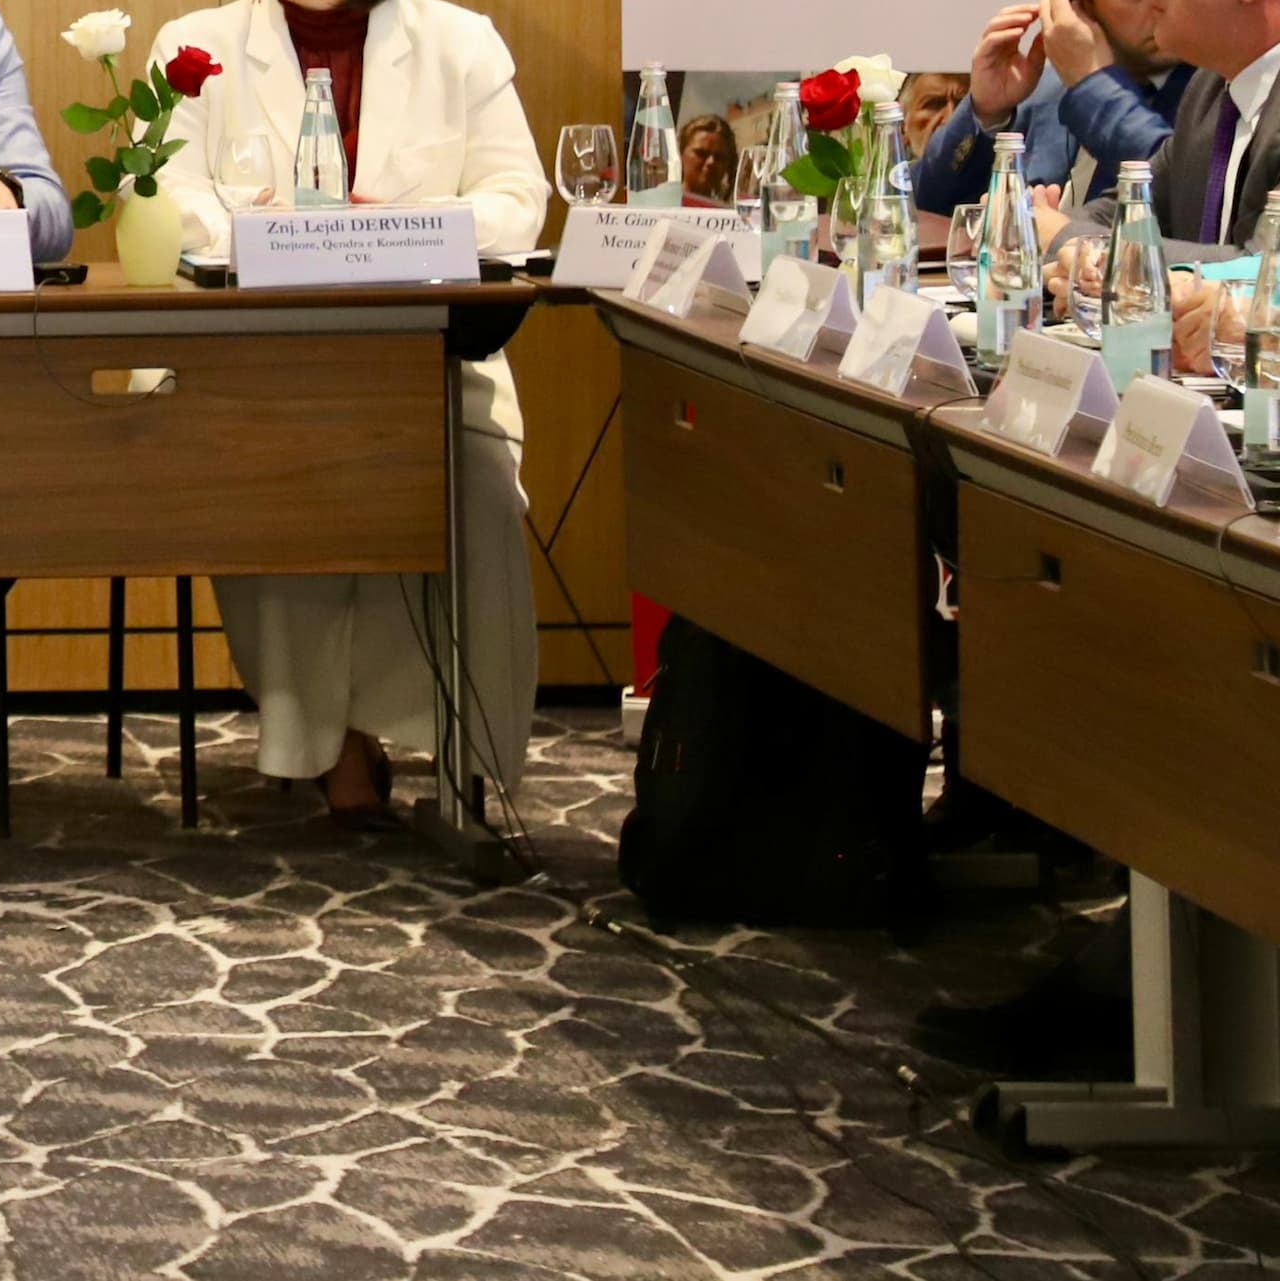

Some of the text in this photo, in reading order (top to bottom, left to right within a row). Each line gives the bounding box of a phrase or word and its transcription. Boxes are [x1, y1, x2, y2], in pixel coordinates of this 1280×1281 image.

[595, 212, 618, 225] Mr.
[266, 216, 443, 236] Znj. Lejdi DERVISHI
[322, 240, 364, 251] Qendra
[377, 237, 444, 248] Koordinimit
[345, 253, 372, 263] CVE
